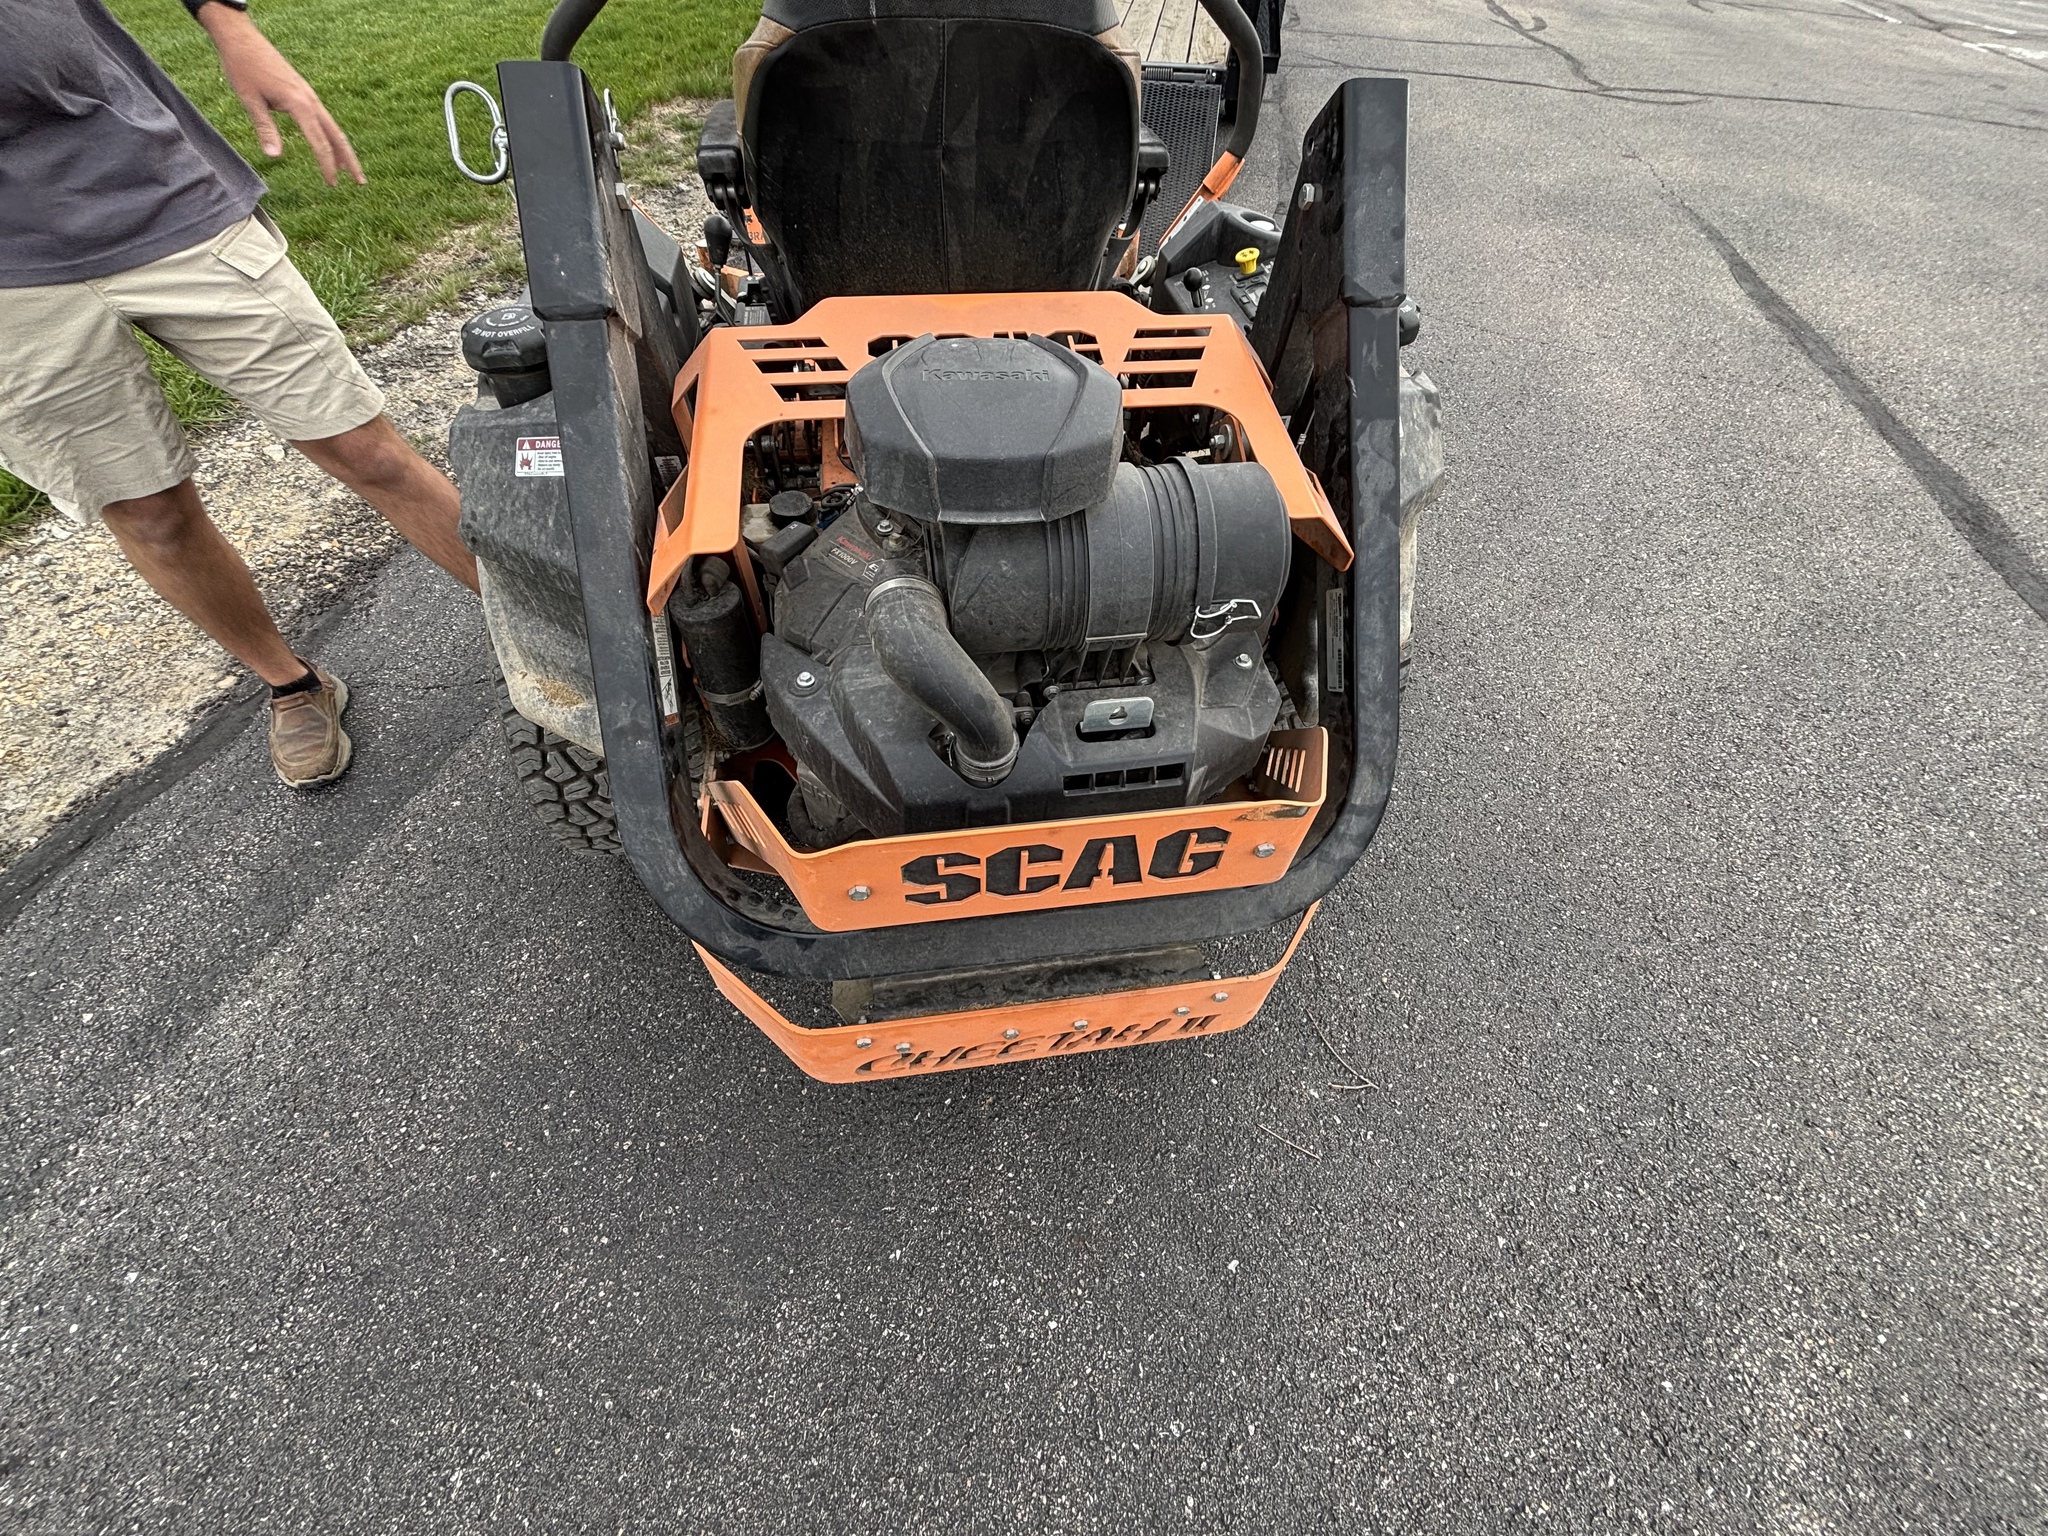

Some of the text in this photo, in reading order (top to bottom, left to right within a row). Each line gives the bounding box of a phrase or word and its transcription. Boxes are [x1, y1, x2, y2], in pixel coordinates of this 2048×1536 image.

[471, 324, 535, 338] DO NOT OVERFILL
[922, 368, 1050, 382] Kawasaki
[535, 440, 561, 449] DANGE
[837, 535, 875, 560] Kawasaki
[900, 826, 1233, 908] SCAG
